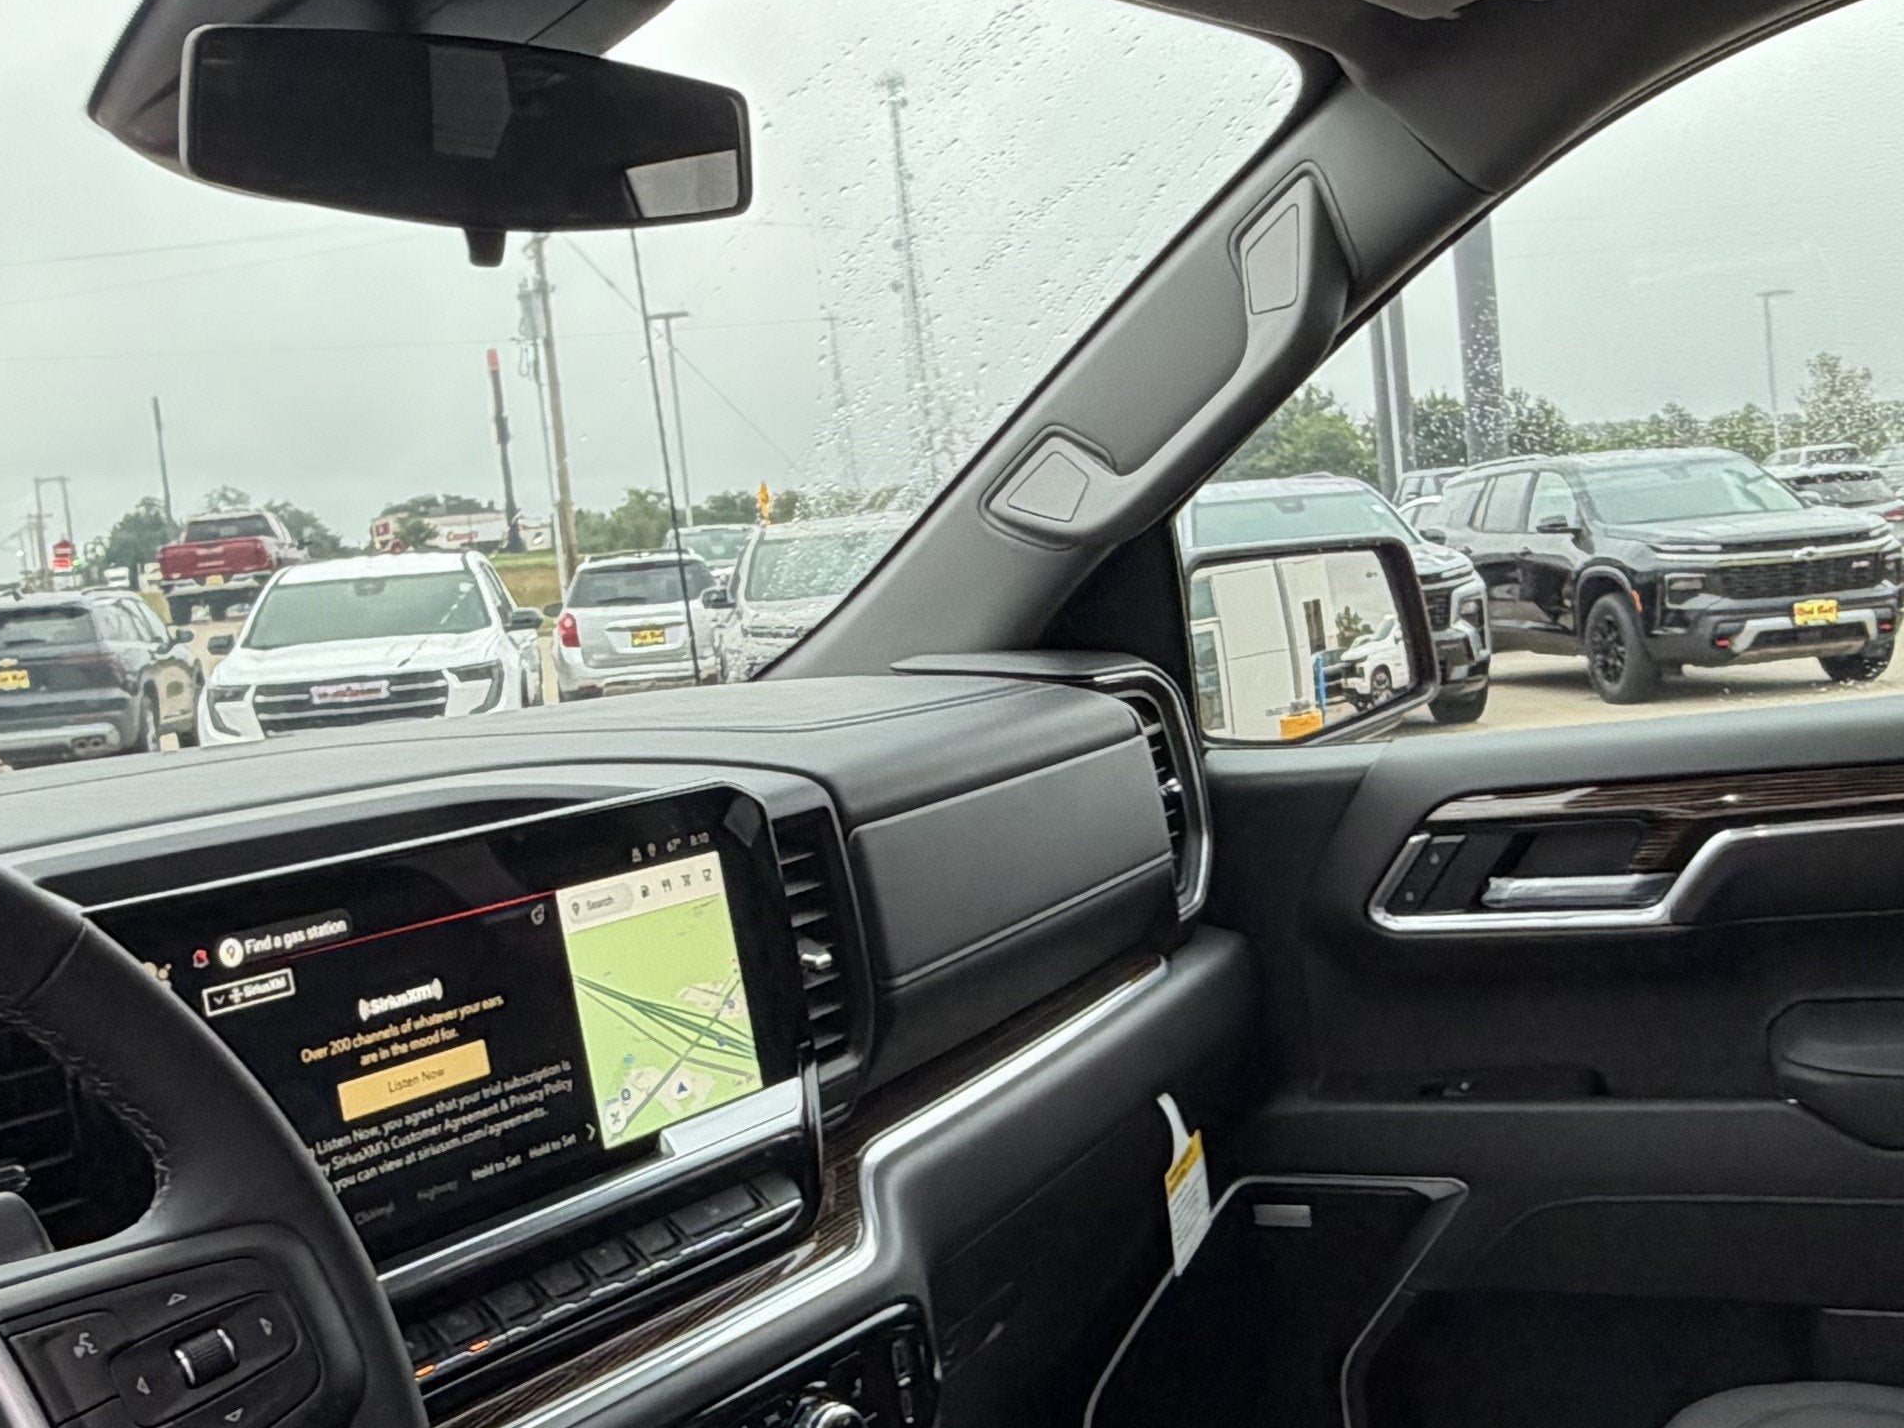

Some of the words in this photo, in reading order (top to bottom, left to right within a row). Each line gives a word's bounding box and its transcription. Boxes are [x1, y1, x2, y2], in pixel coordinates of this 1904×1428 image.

[243, 933, 272, 956] Find
[272, 934, 282, 948] a
[282, 929, 306, 949] gas
[305, 916, 347, 941] station
[300, 1042, 329, 1064] Over
[328, 1035, 352, 1056] 200
[351, 1021, 399, 1049] channels
[399, 1017, 412, 1035] of
[411, 1004, 458, 1031] whatever
[457, 1000, 482, 1020] your
[359, 1050, 378, 1066] are
[378, 1044, 390, 1060] in
[389, 1038, 409, 1057] the
[408, 1029, 440, 1051] mood
[387, 1072, 419, 1094] Listen
[421, 1064, 445, 1083] Now
[527, 1140, 551, 1159] Hold
[551, 1139, 561, 1151] to
[561, 1131, 576, 1147] Set
[470, 1161, 494, 1181] Hold
[494, 1159, 505, 1173] to
[505, 1151, 522, 1168] Set
